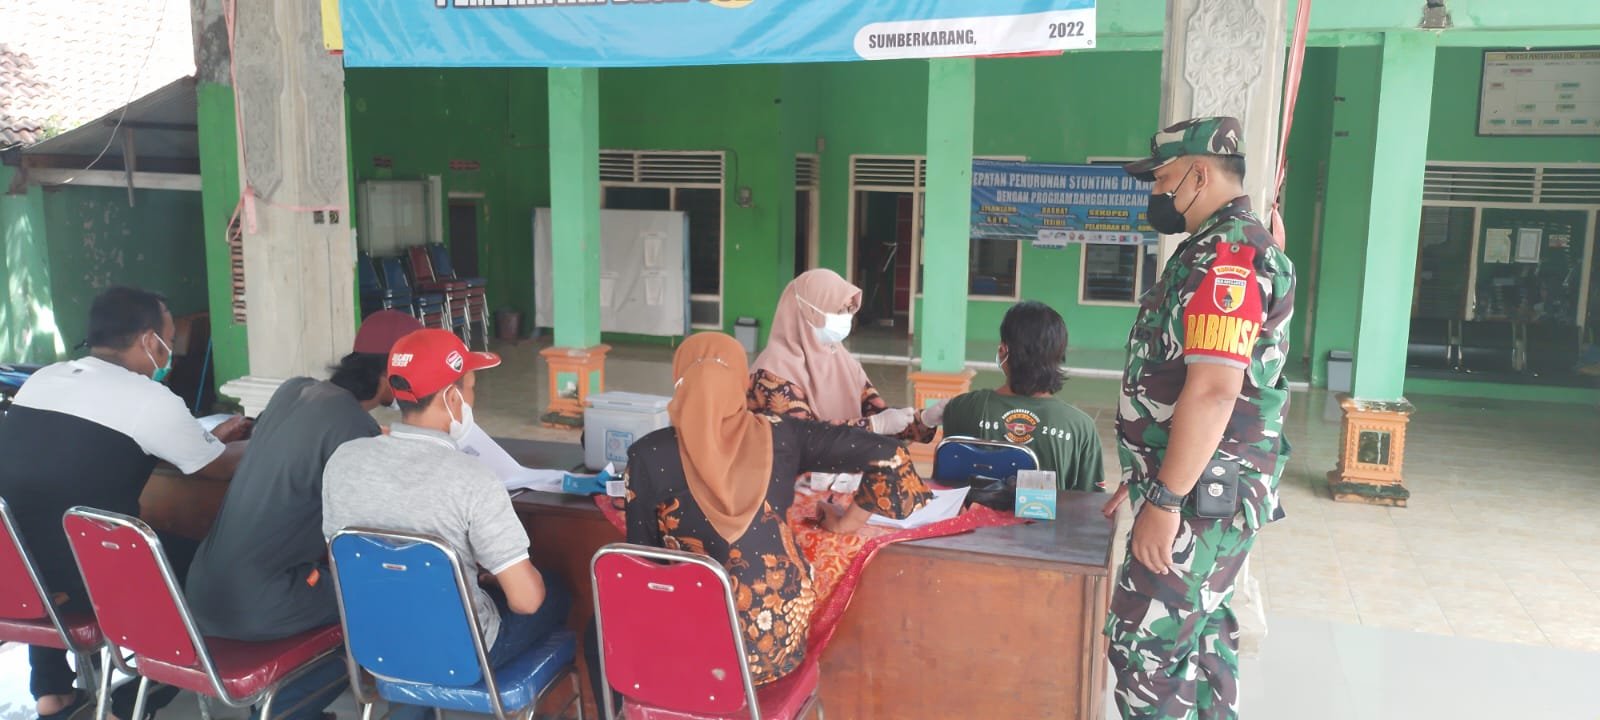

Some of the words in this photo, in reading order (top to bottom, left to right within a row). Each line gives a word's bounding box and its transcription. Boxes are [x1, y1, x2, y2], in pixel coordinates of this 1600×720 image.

[868, 29, 977, 49] SUMBERKARANG,
[1048, 21, 1085, 39] 2022
[1009, 174, 1067, 188] PENURUNAN
[1069, 176, 1119, 190] STUNTING
[1031, 192, 1074, 205] PROGRAM
[1108, 195, 1149, 207] KENCANA
[1042, 425, 1072, 441] 2020
